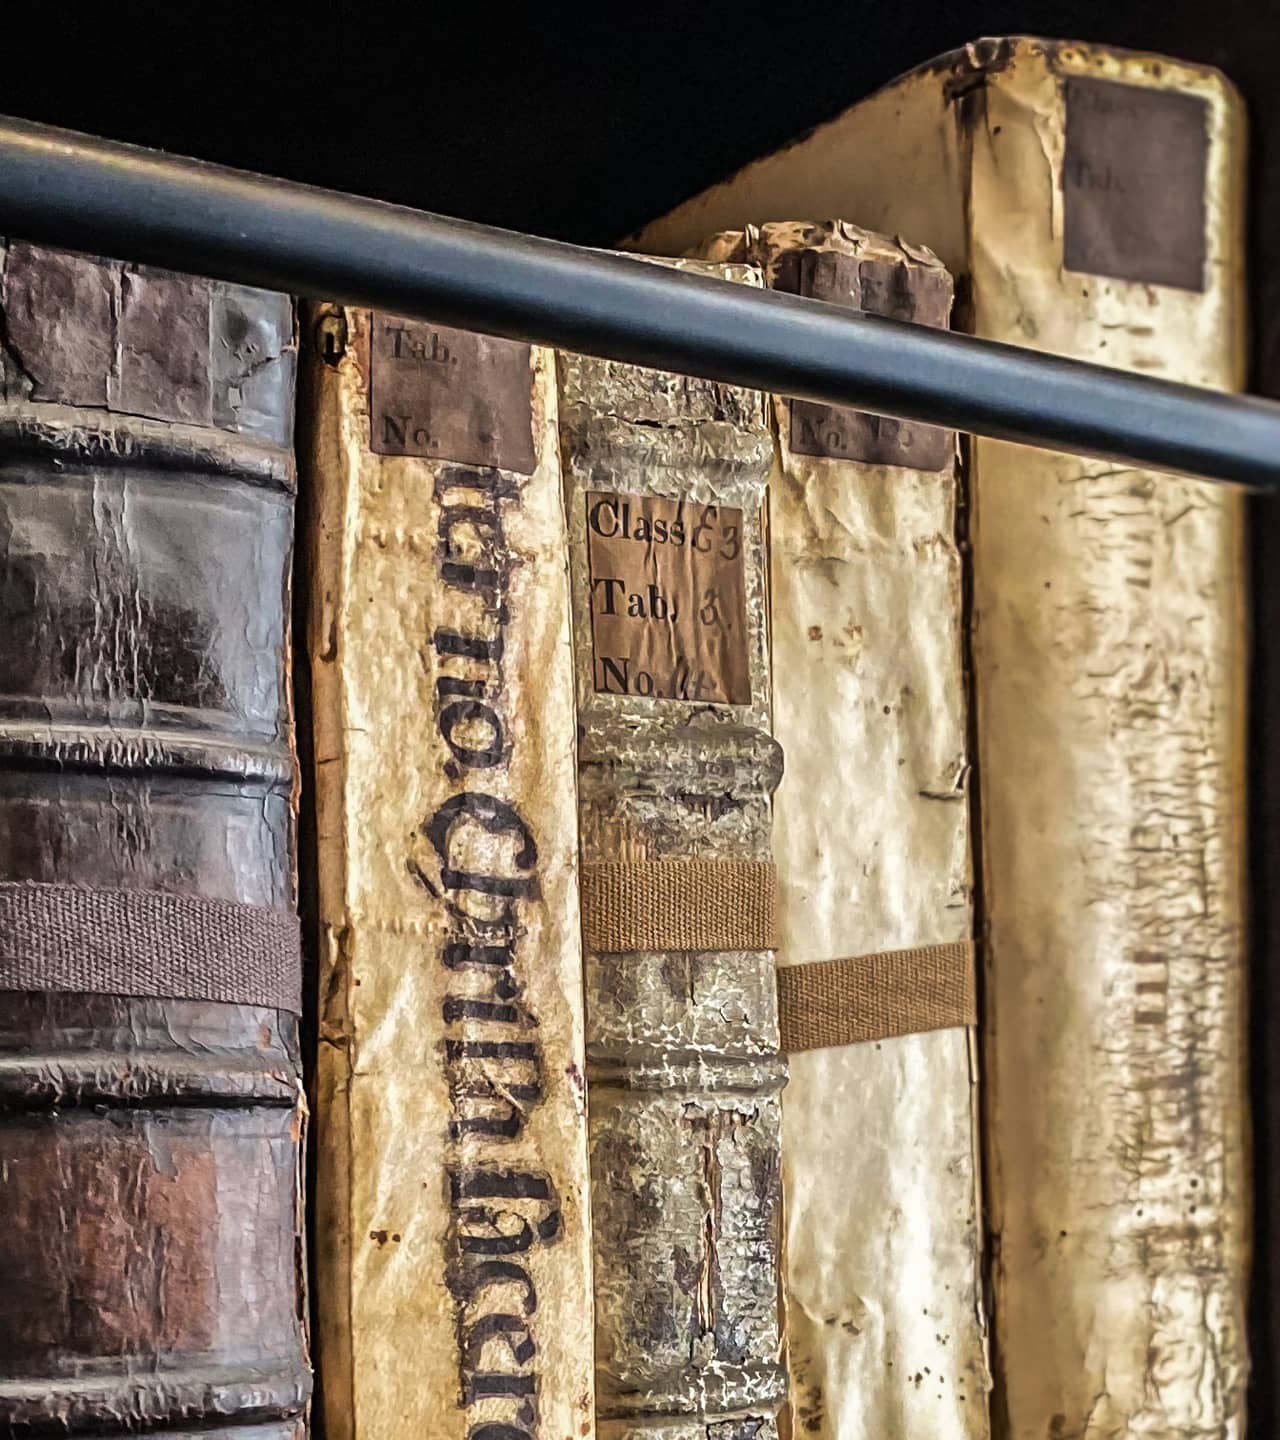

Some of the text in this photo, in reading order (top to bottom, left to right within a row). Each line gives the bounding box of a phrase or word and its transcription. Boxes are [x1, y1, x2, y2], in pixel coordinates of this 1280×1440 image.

[385, 326, 458, 366] Tab.
[383, 415, 440, 449] No.
[799, 415, 848, 450] No.
[590, 500, 686, 547] Class
[600, 656, 664, 697] No.
